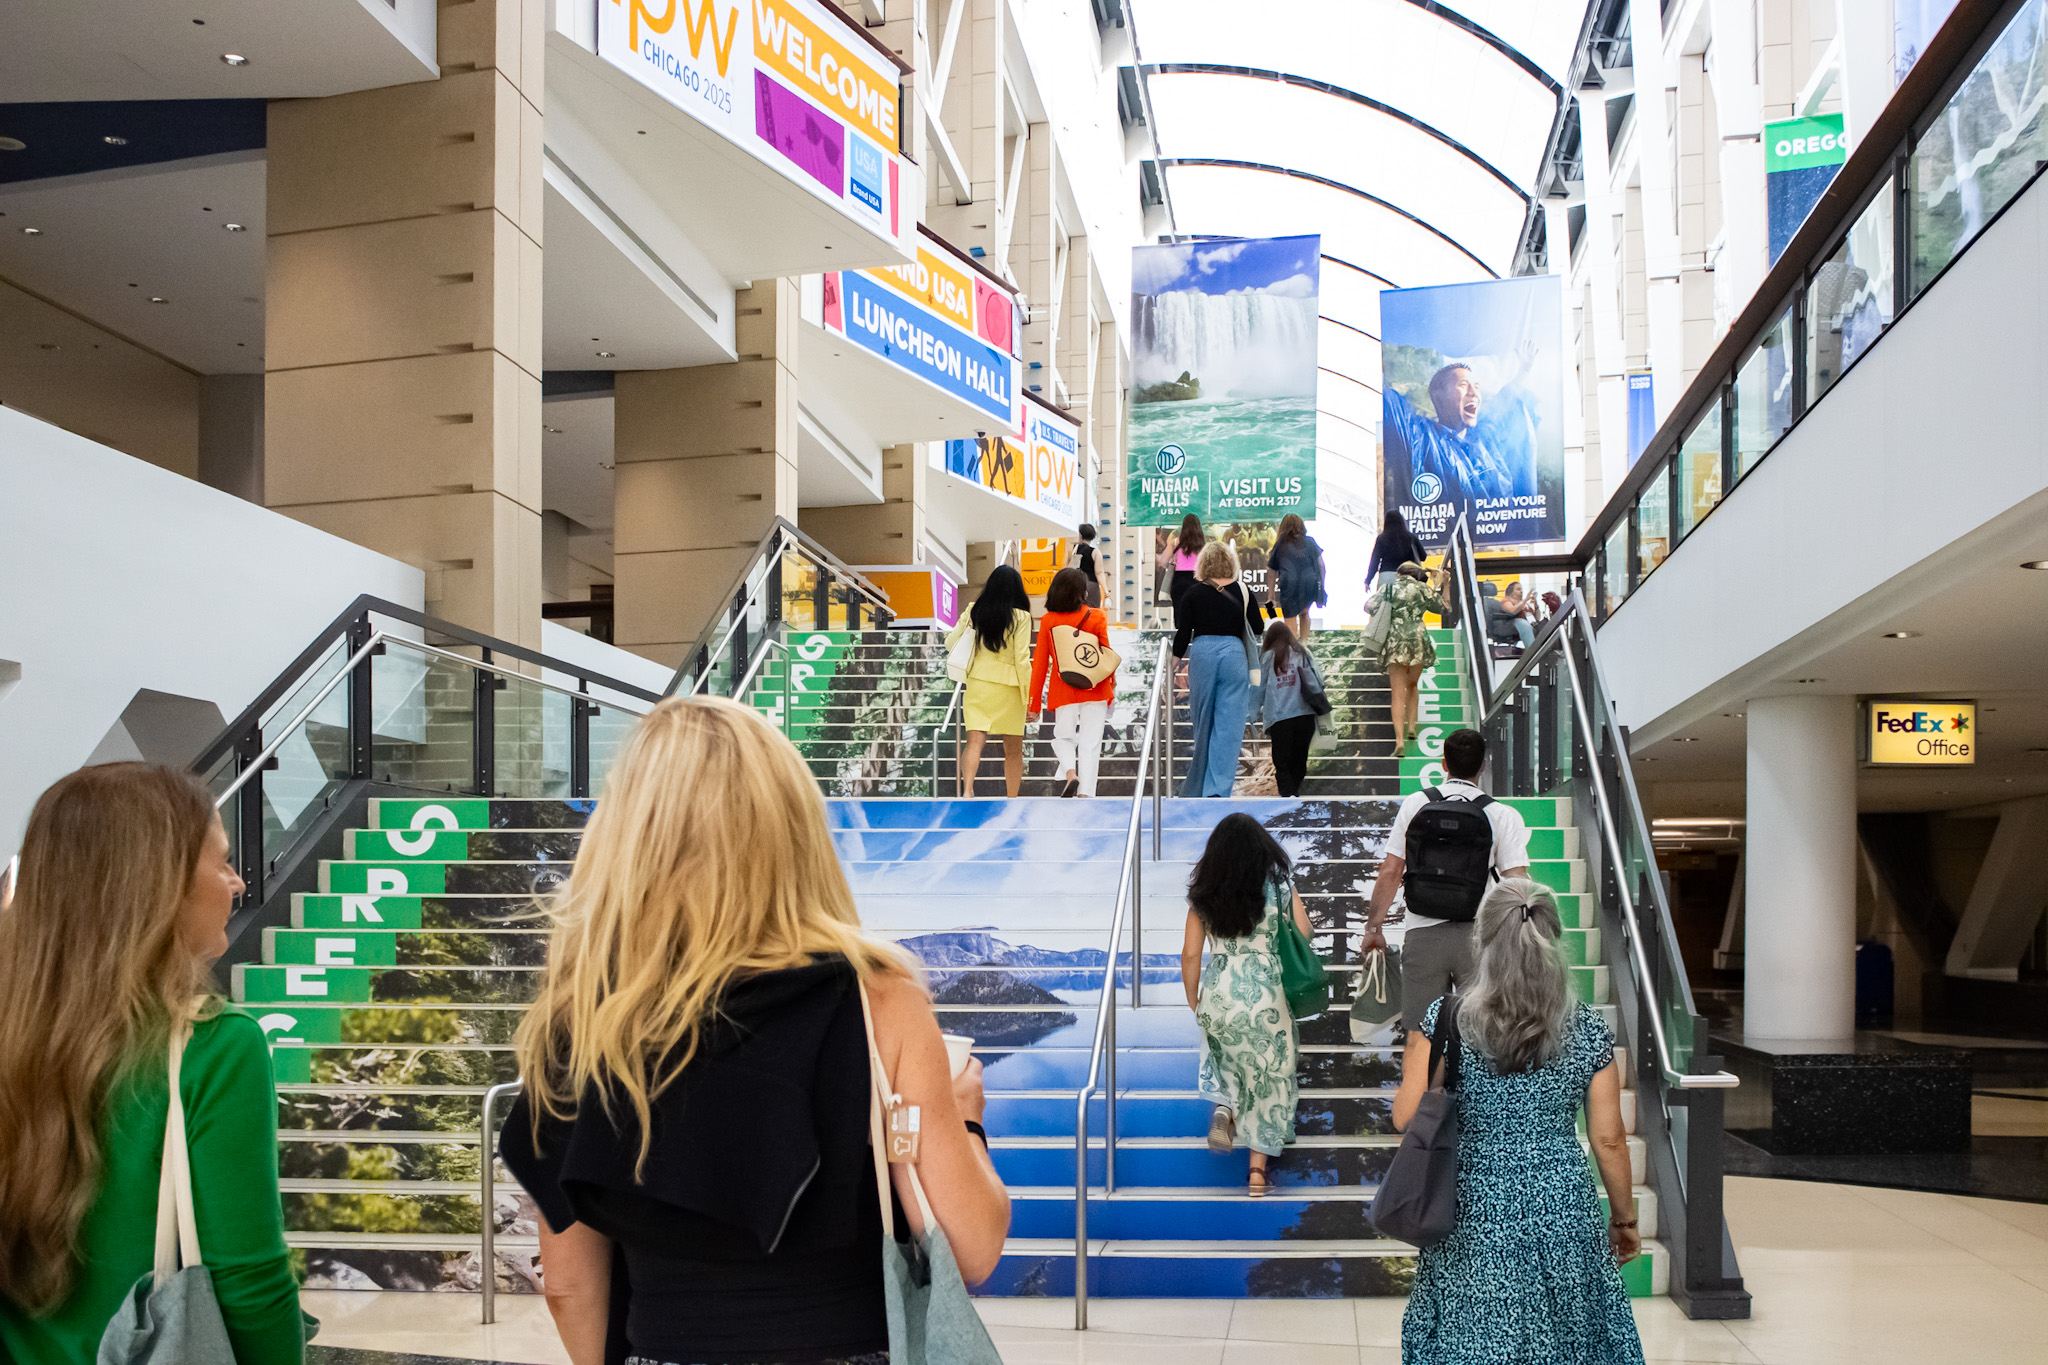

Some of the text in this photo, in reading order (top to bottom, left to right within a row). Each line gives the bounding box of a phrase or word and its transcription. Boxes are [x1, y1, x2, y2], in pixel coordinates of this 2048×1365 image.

[609, 0, 739, 79] pw
[643, 39, 732, 114] CHICAGO 2025
[755, 0, 895, 141] WELCOME
[855, 145, 878, 178] USA
[853, 183, 880, 209] Brand USA
[884, 262, 968, 320] AND USA
[852, 291, 1010, 408] LUNCHEON HALL
[1042, 424, 1052, 440] U.S.
[1141, 475, 1199, 494] NIAGARA
[1219, 476, 1302, 496] VISIT US
[1151, 492, 1190, 508] FALLS
[1219, 496, 1302, 508] AT BOOTH 2317
[1475, 495, 1547, 509] PLAN YOUR
[1160, 508, 1181, 516] USA
[1399, 502, 1456, 521] NIAGARA
[1475, 507, 1547, 522] ADVENTURE
[1409, 518, 1447, 534] FALLS
[1475, 522, 1507, 535] NOW
[1418, 533, 1439, 541] USA
[1238, 569, 1268, 583] ISIT
[1877, 711, 1945, 733] FedEx
[1916, 738, 1970, 756] Office
